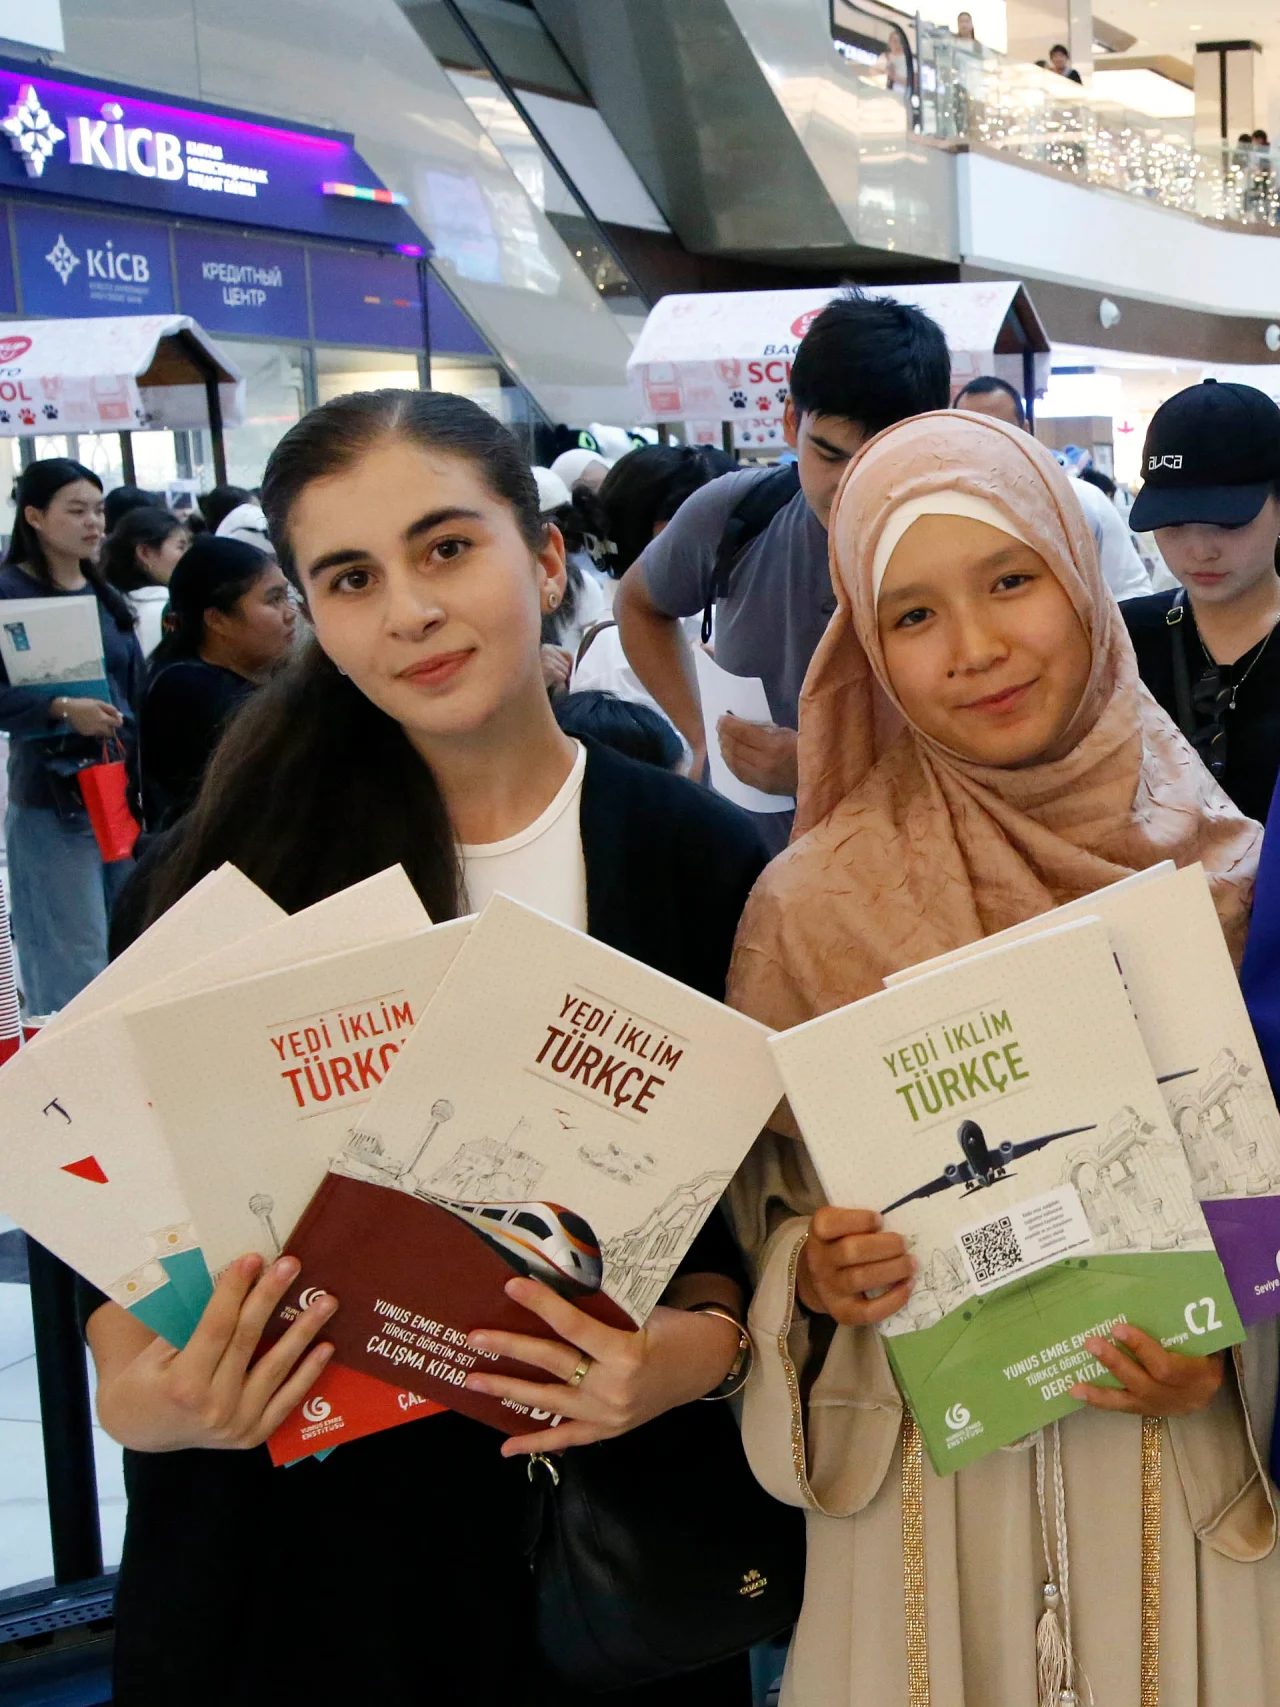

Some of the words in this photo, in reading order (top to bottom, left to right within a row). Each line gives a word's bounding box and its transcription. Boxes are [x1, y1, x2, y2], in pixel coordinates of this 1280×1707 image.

[202, 262, 283, 287] КРЕДИТНЫЙ
[223, 286, 267, 307] ЦЕНТР
[270, 1018, 332, 1061] YEDİ
[338, 1001, 415, 1043] İKLİM
[558, 993, 617, 1039] YEDİ
[615, 1017, 684, 1072] İKLİM
[882, 1032, 939, 1078] YEDİ
[941, 1009, 1013, 1054] İKLİM
[535, 1024, 665, 1115] TÜRKÇE
[895, 1042, 1030, 1122] TÜRKÇE
[1254, 1278, 1280, 1296] Seviye
[373, 1299, 412, 1324] YUNUS
[410, 1314, 444, 1337] EMRE
[1160, 1331, 1189, 1348] Seviye
[1184, 1297, 1223, 1336] C2
[366, 1335, 426, 1371] ÇALIŞMA
[381, 1322, 417, 1344] TÜRKÇE
[415, 1334, 456, 1360] ÖĞRETİM
[454, 1352, 477, 1368] SETİ
[1002, 1354, 1040, 1380] YUNUS
[1039, 1340, 1071, 1364] EMRE
[1025, 1364, 1059, 1387] TÜRKÇE
[1041, 1374, 1075, 1401] DERS
[1076, 1361, 1110, 1384] KİTA
